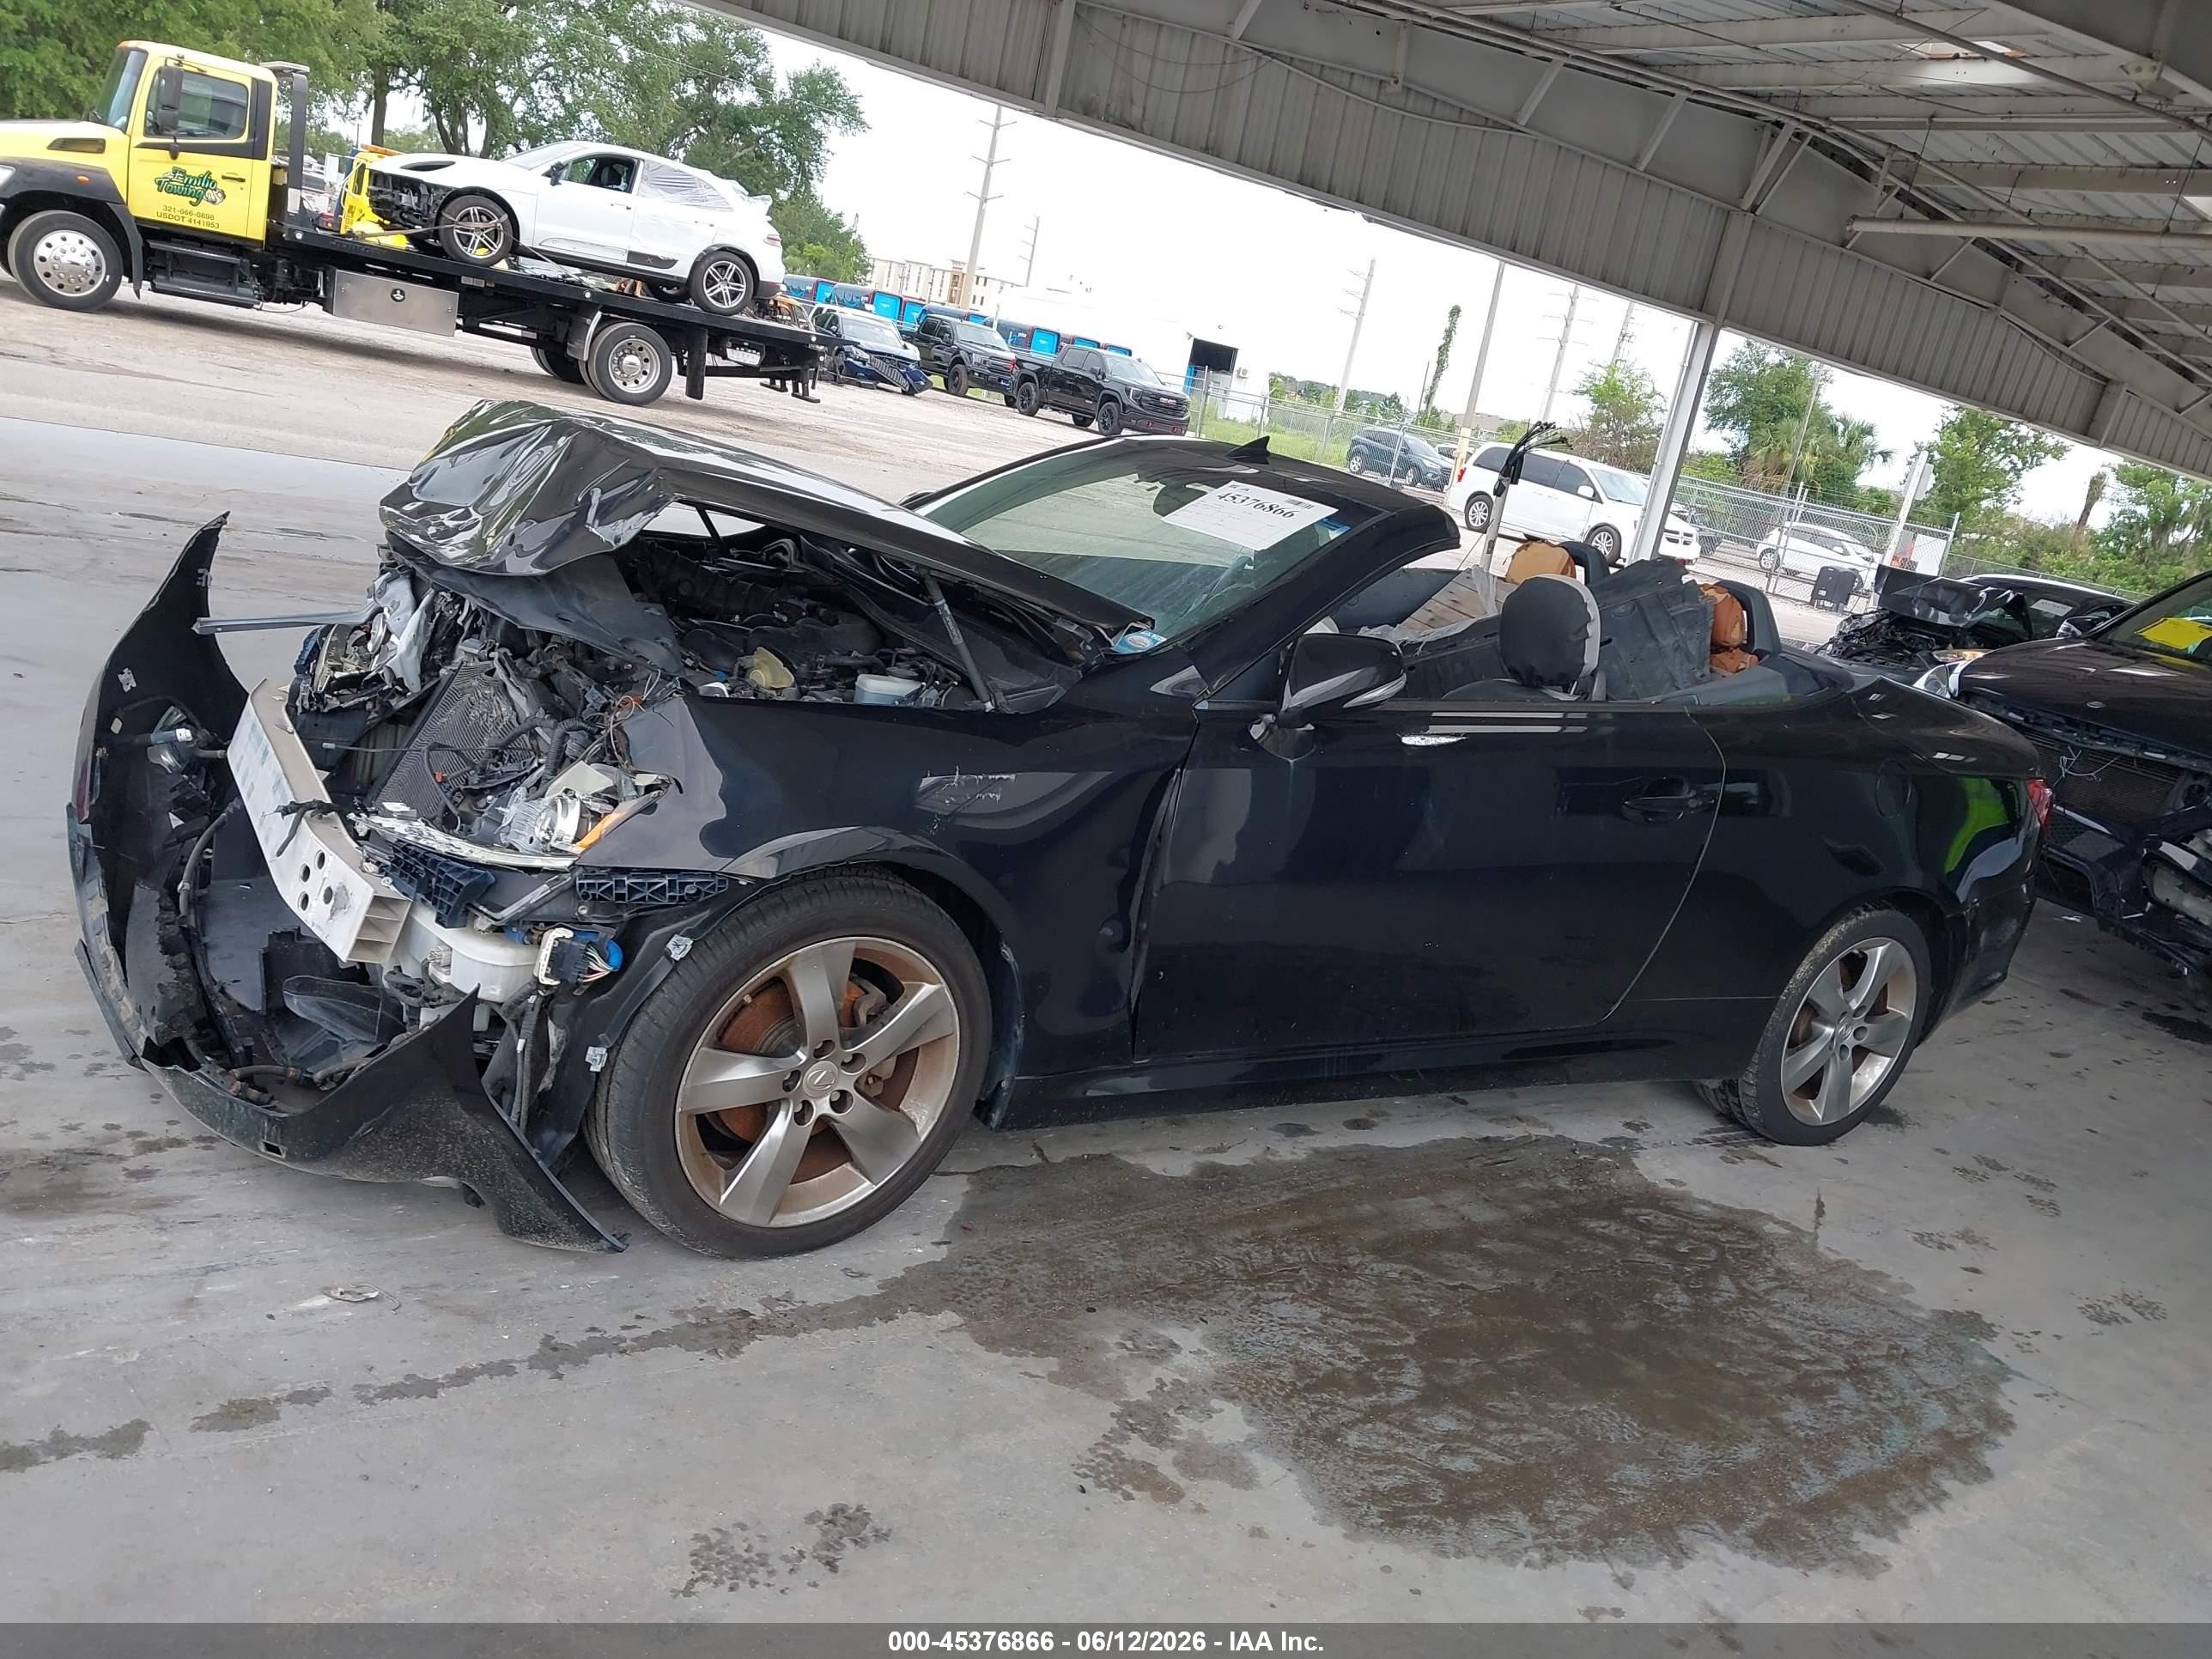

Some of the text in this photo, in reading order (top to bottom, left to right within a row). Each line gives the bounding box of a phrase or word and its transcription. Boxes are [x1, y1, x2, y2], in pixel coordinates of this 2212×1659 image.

[155, 177, 205, 206] Towing
[172, 166, 218, 191] Emilio
[156, 212, 220, 228] USDOT 4141953
[1217, 492, 1299, 519] 45376866
